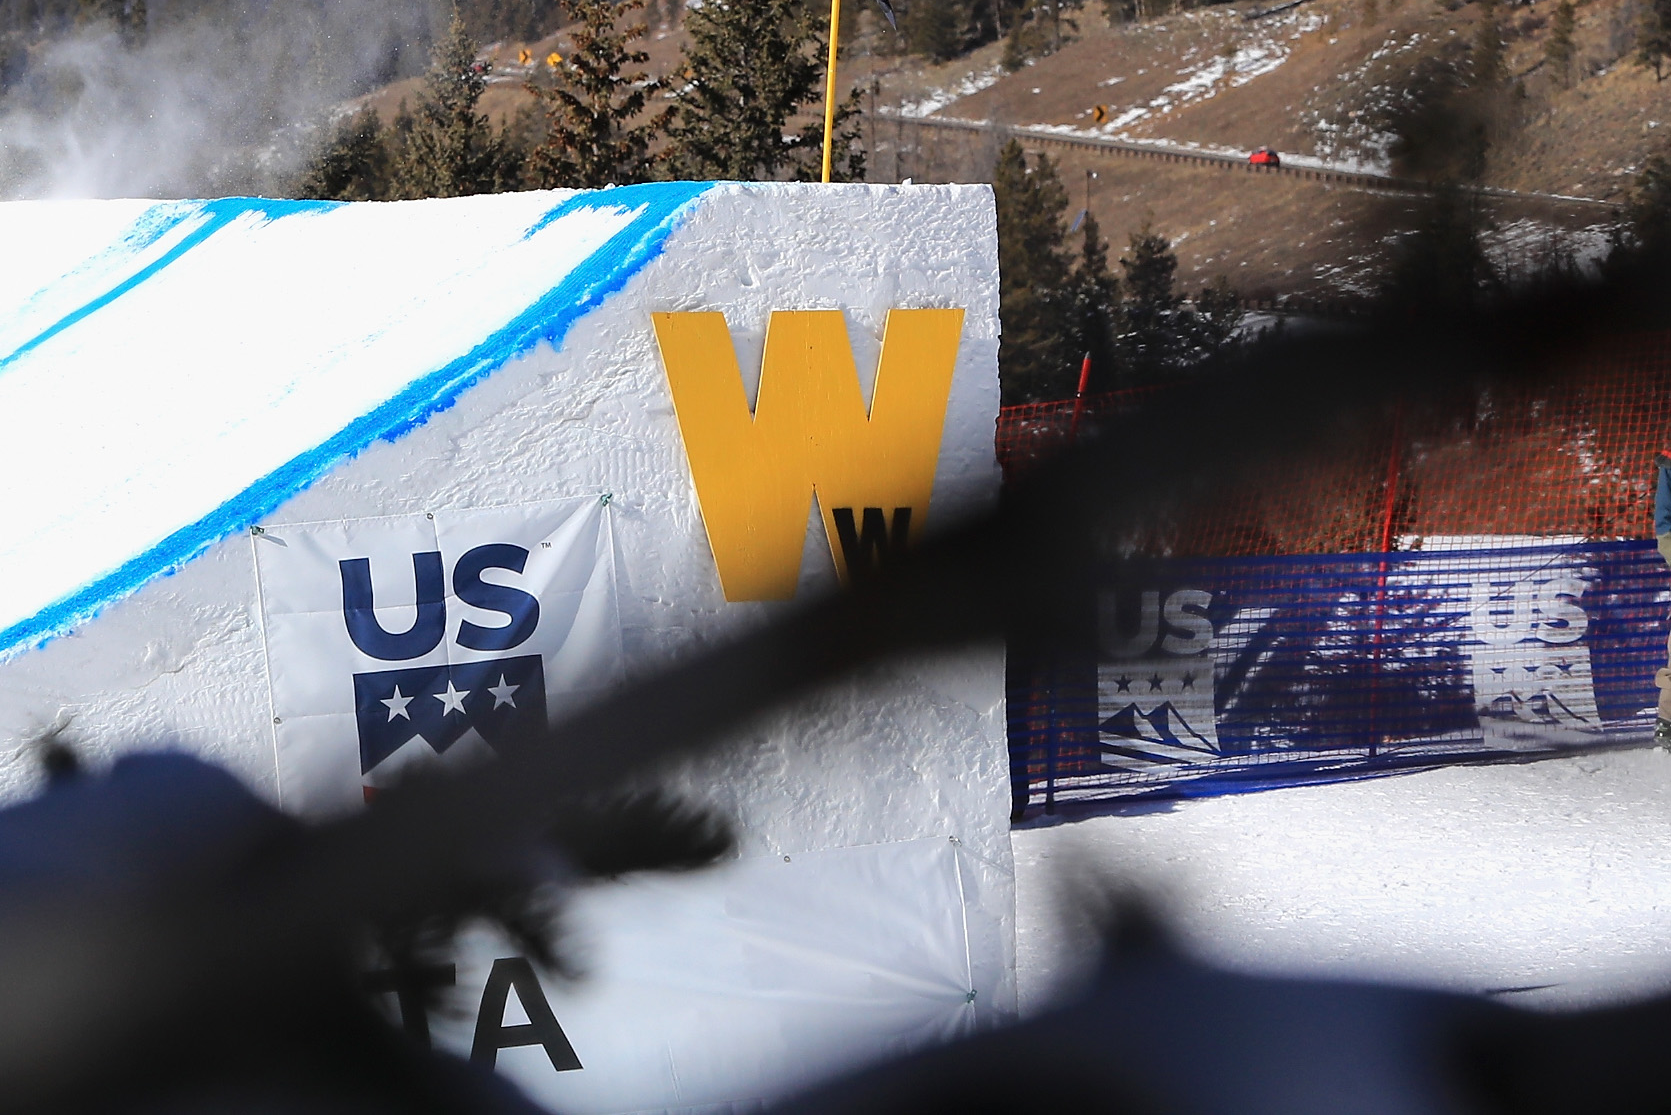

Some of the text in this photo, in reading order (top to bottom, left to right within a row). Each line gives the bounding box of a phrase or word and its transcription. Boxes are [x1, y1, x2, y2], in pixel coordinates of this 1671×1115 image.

[651, 308, 965, 602] W
[339, 543, 541, 661] US
[1097, 589, 1214, 658] US
[1471, 577, 1589, 644] US
